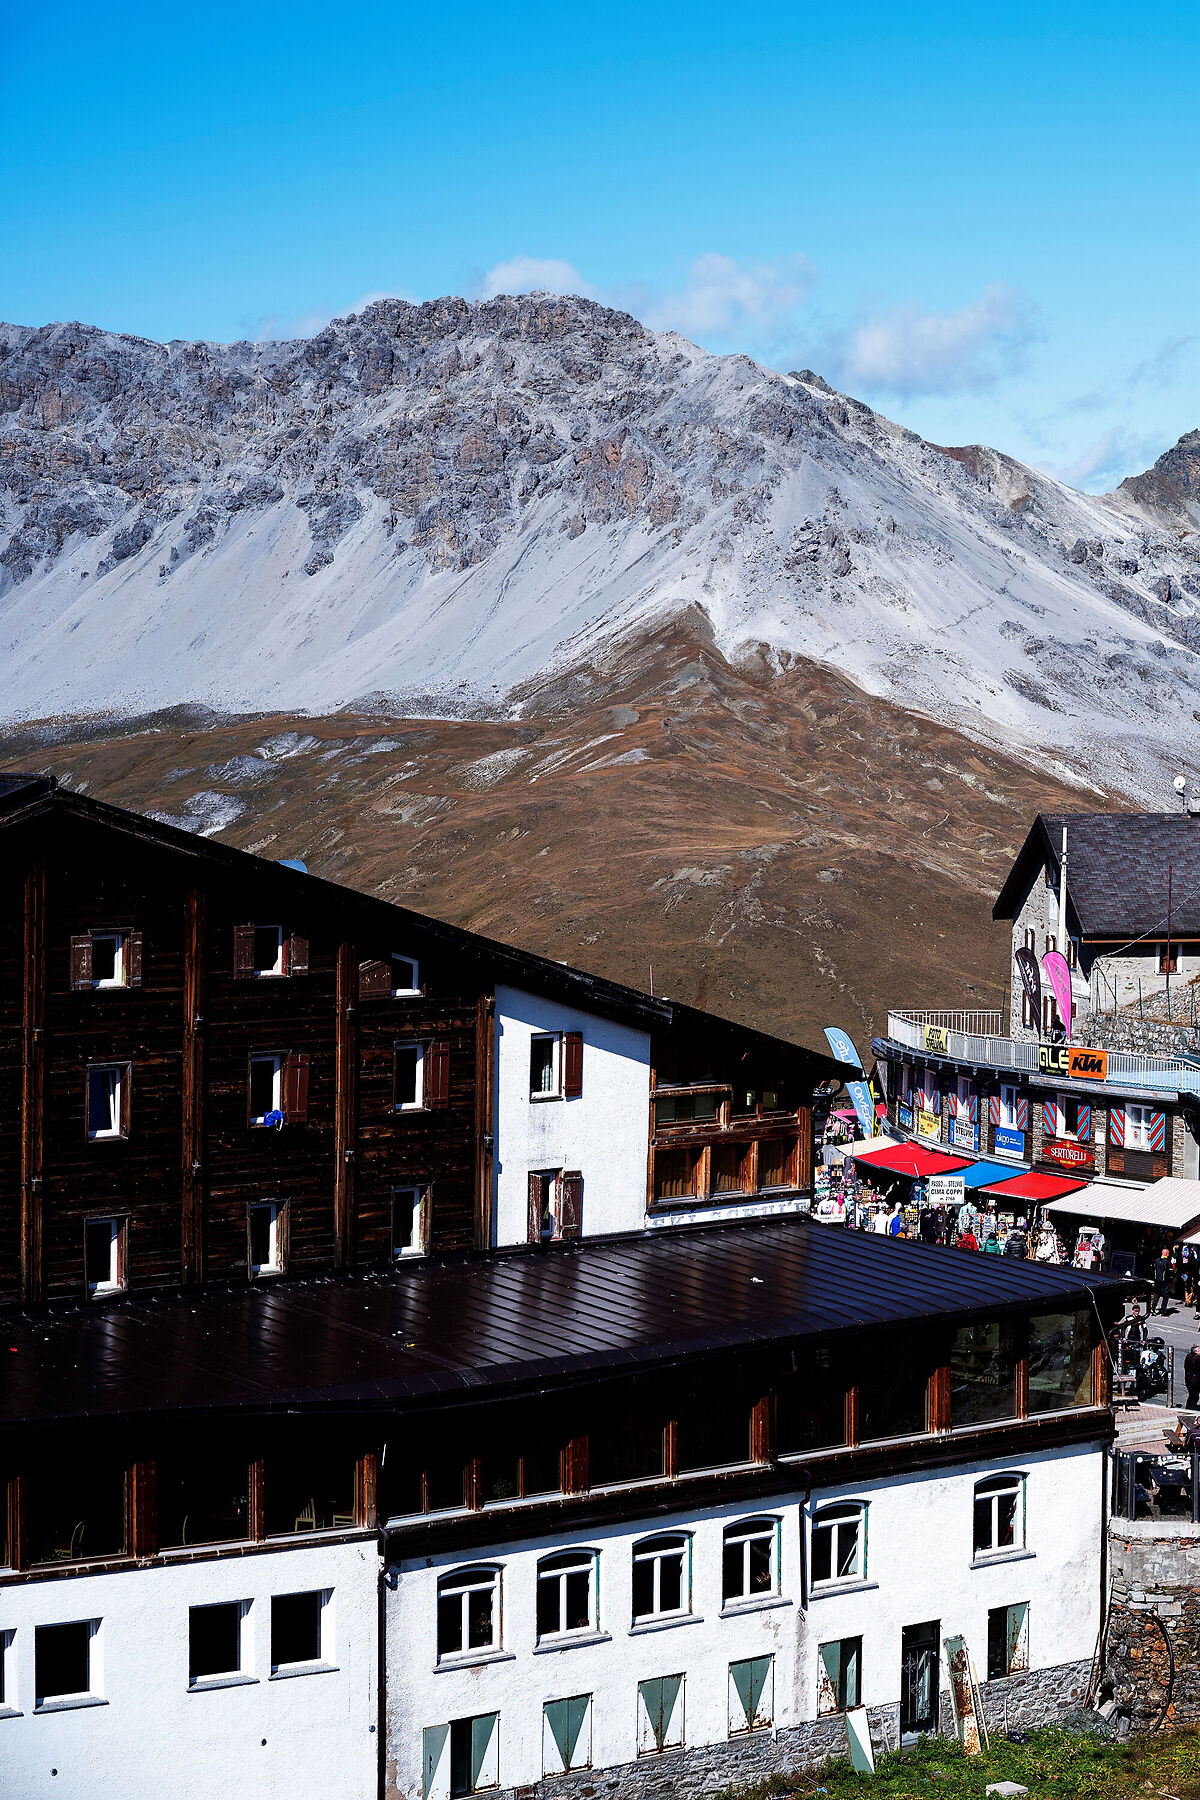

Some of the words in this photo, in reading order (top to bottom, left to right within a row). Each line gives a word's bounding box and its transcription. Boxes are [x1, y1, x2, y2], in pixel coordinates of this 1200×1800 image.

[1071, 1053, 1103, 1073] KTM
[955, 1125, 974, 1139] STELVIO
[1050, 1147, 1087, 1161] SERTORELLI
